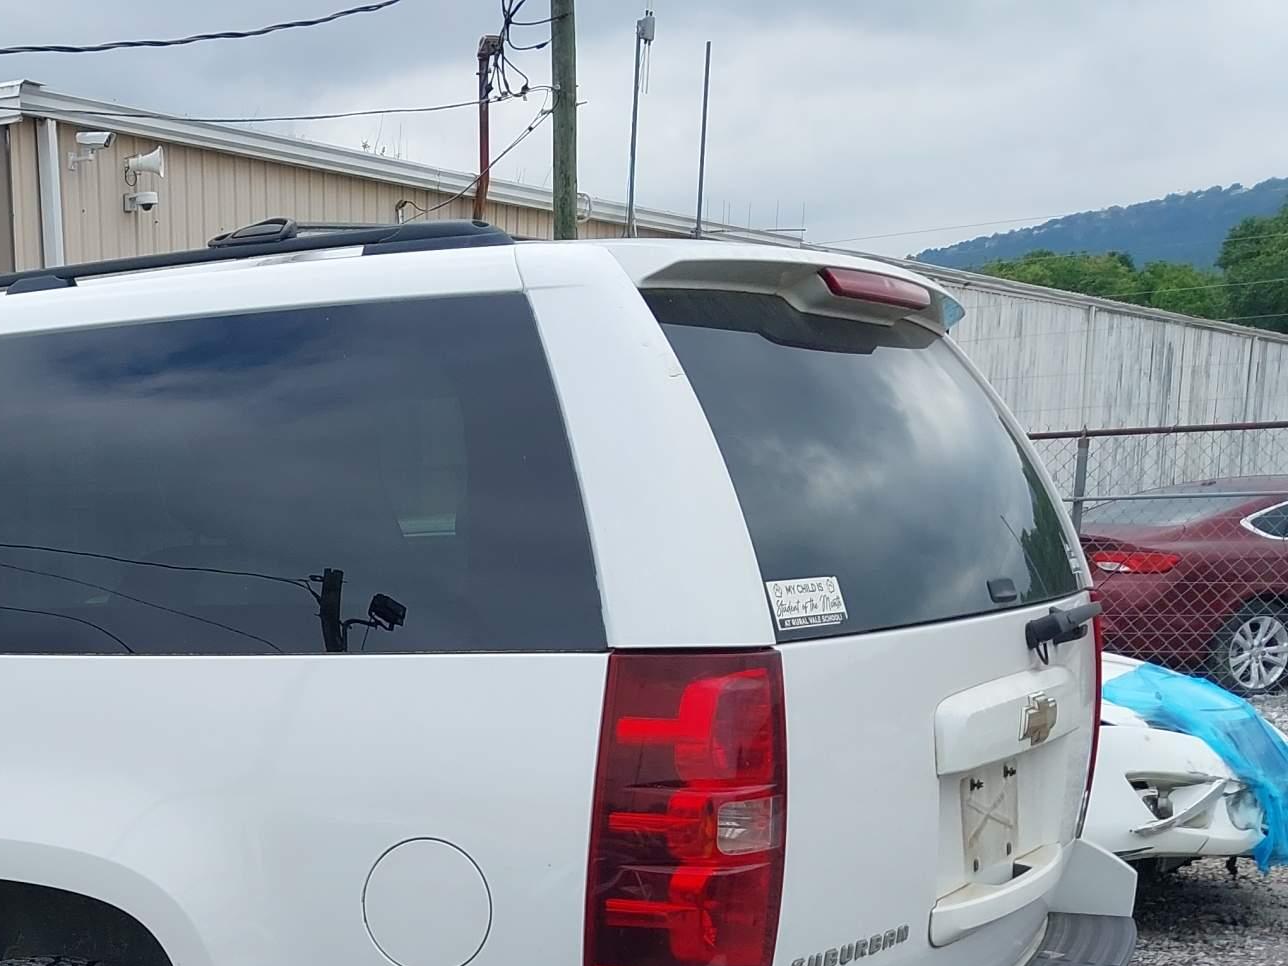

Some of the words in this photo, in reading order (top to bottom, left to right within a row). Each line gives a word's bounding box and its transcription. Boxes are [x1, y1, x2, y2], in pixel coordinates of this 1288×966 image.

[785, 584, 795, 595] MY
[796, 583, 816, 594] CHILD
[776, 599, 800, 617] Student
[819, 594, 843, 612] Month
